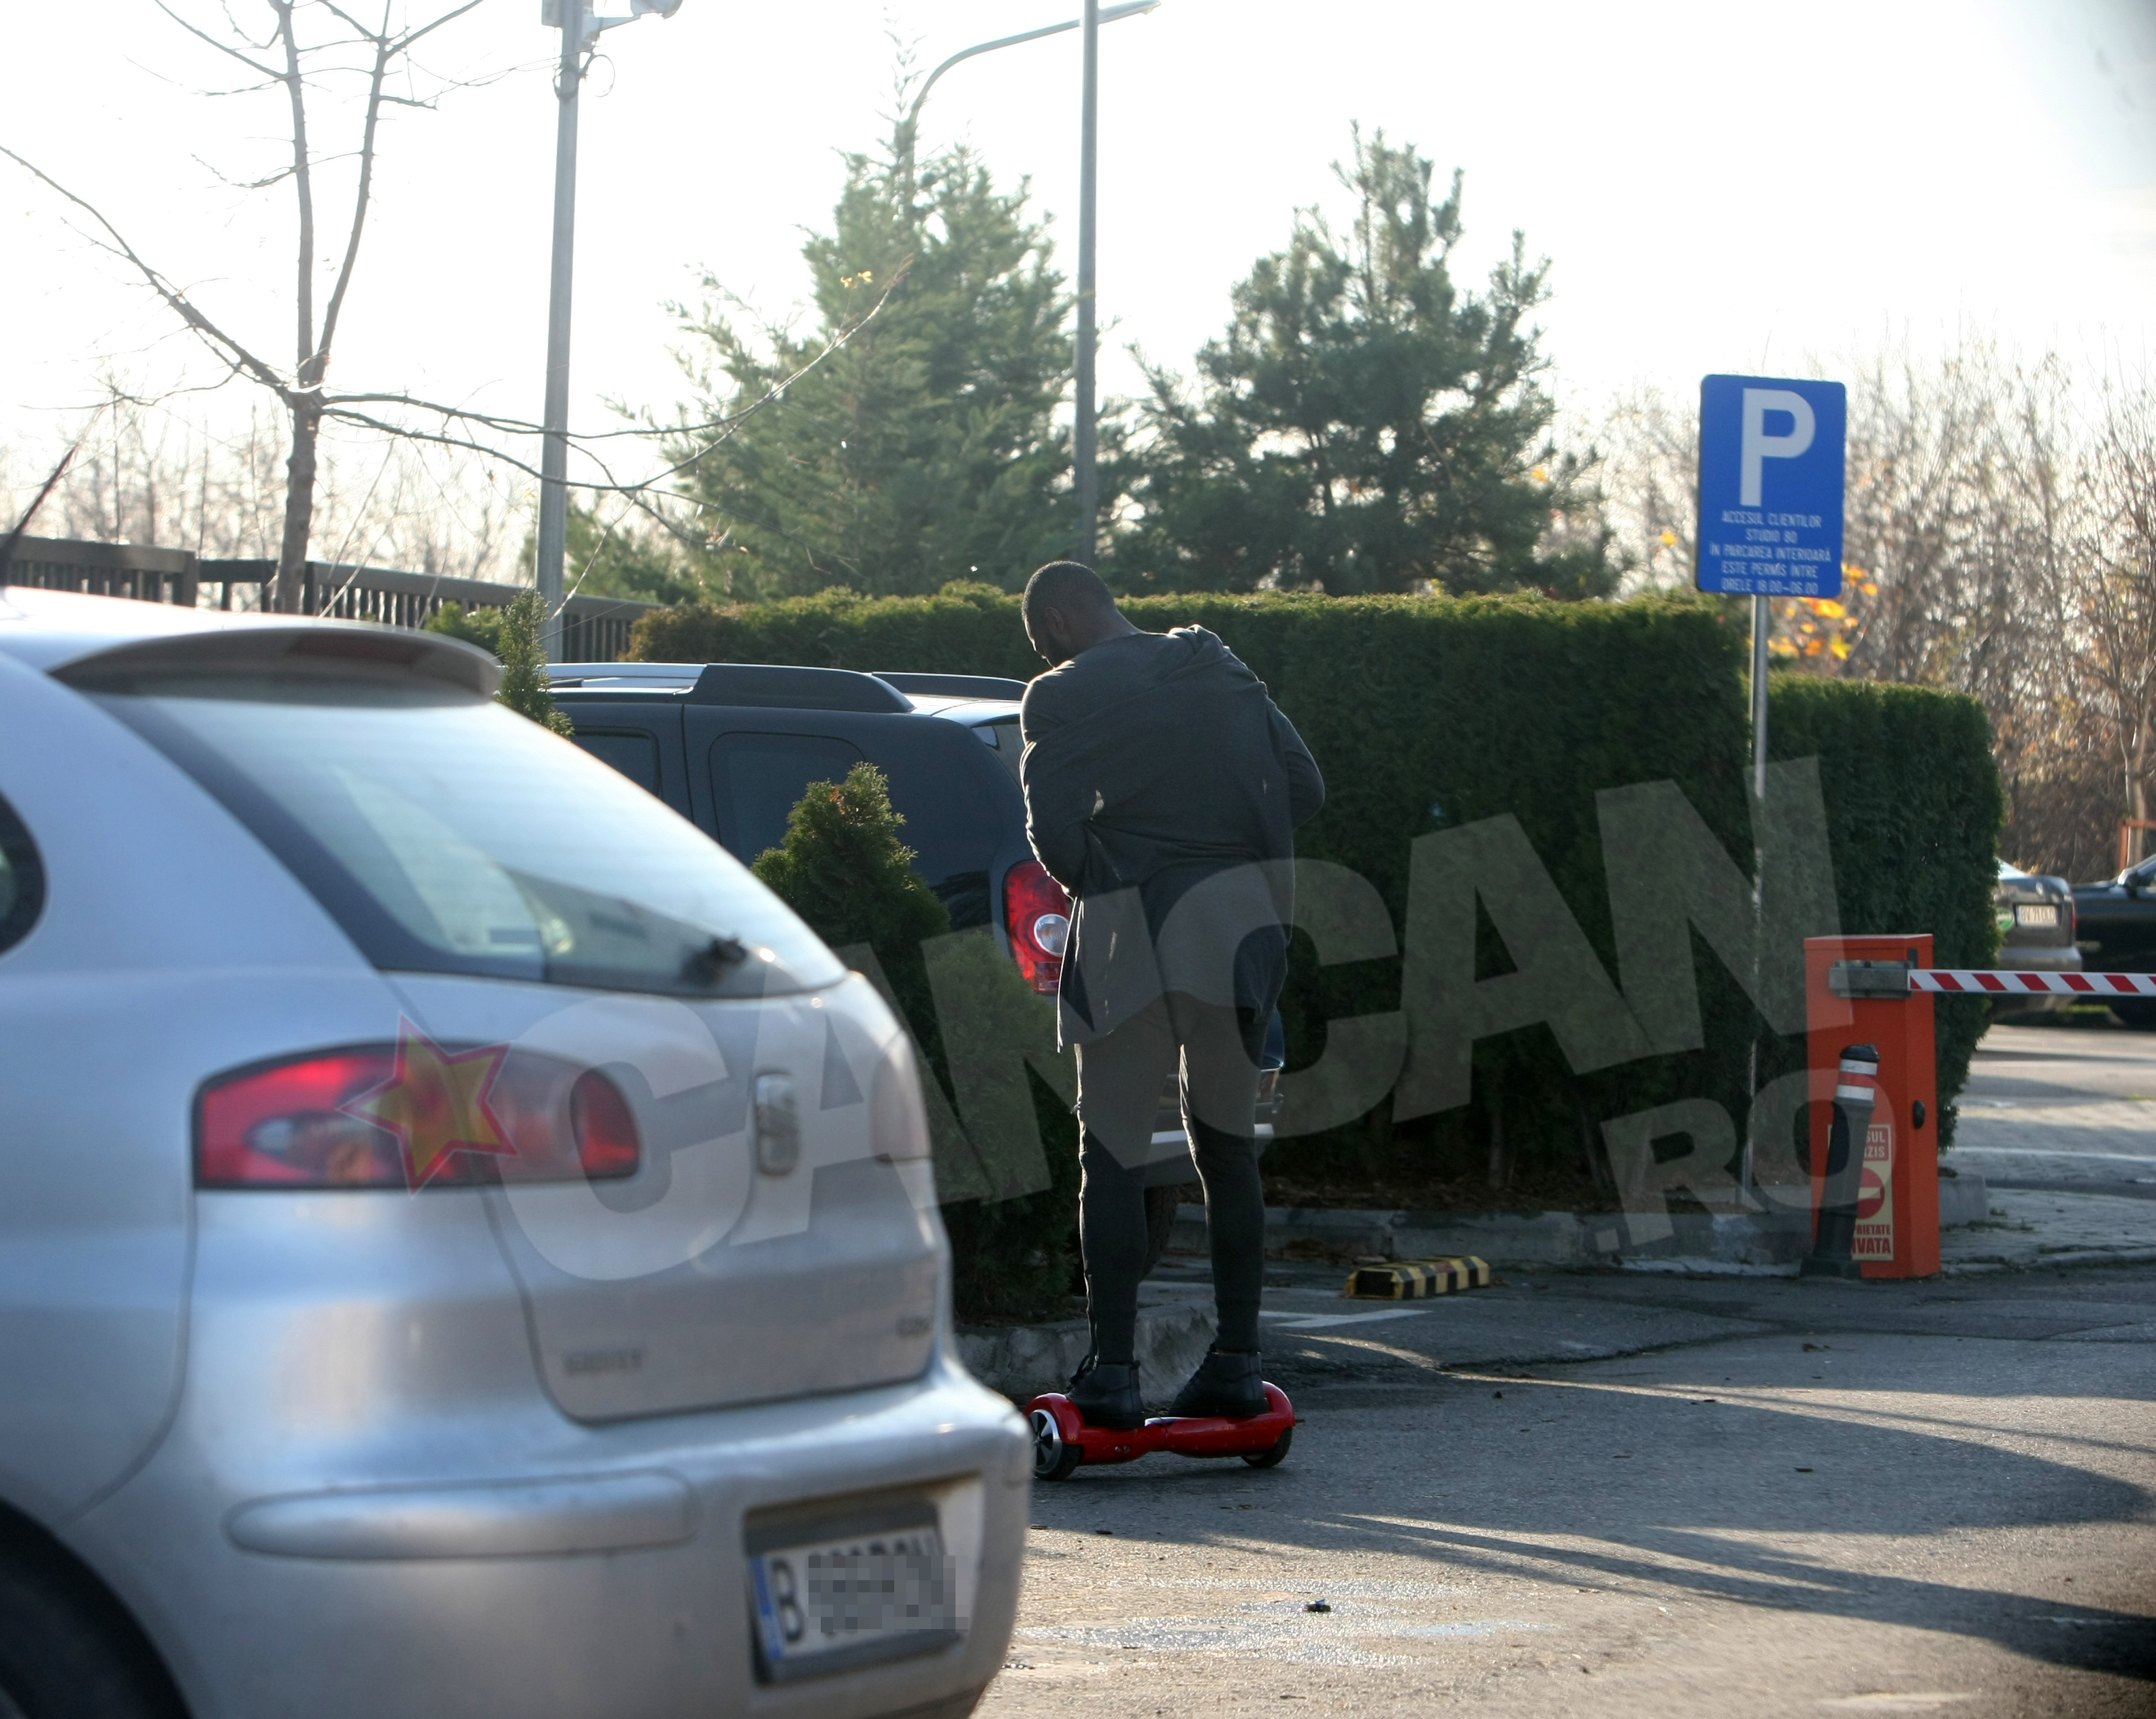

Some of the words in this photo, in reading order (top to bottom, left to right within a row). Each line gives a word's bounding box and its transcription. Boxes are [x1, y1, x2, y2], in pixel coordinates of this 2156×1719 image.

[1740, 388, 1816, 507] P
[1722, 510, 1764, 525] ACCESUL
[1746, 528, 1780, 542] STUDIO
[1723, 544, 1772, 559] PARCAREA
[1721, 561, 1748, 574] ESTE
[1751, 562, 1787, 577] PERMIS
[1721, 578, 1753, 592] ORELE
[1857, 1225, 1891, 1234] RIETATE
[1852, 1238, 1891, 1254] IVATA
